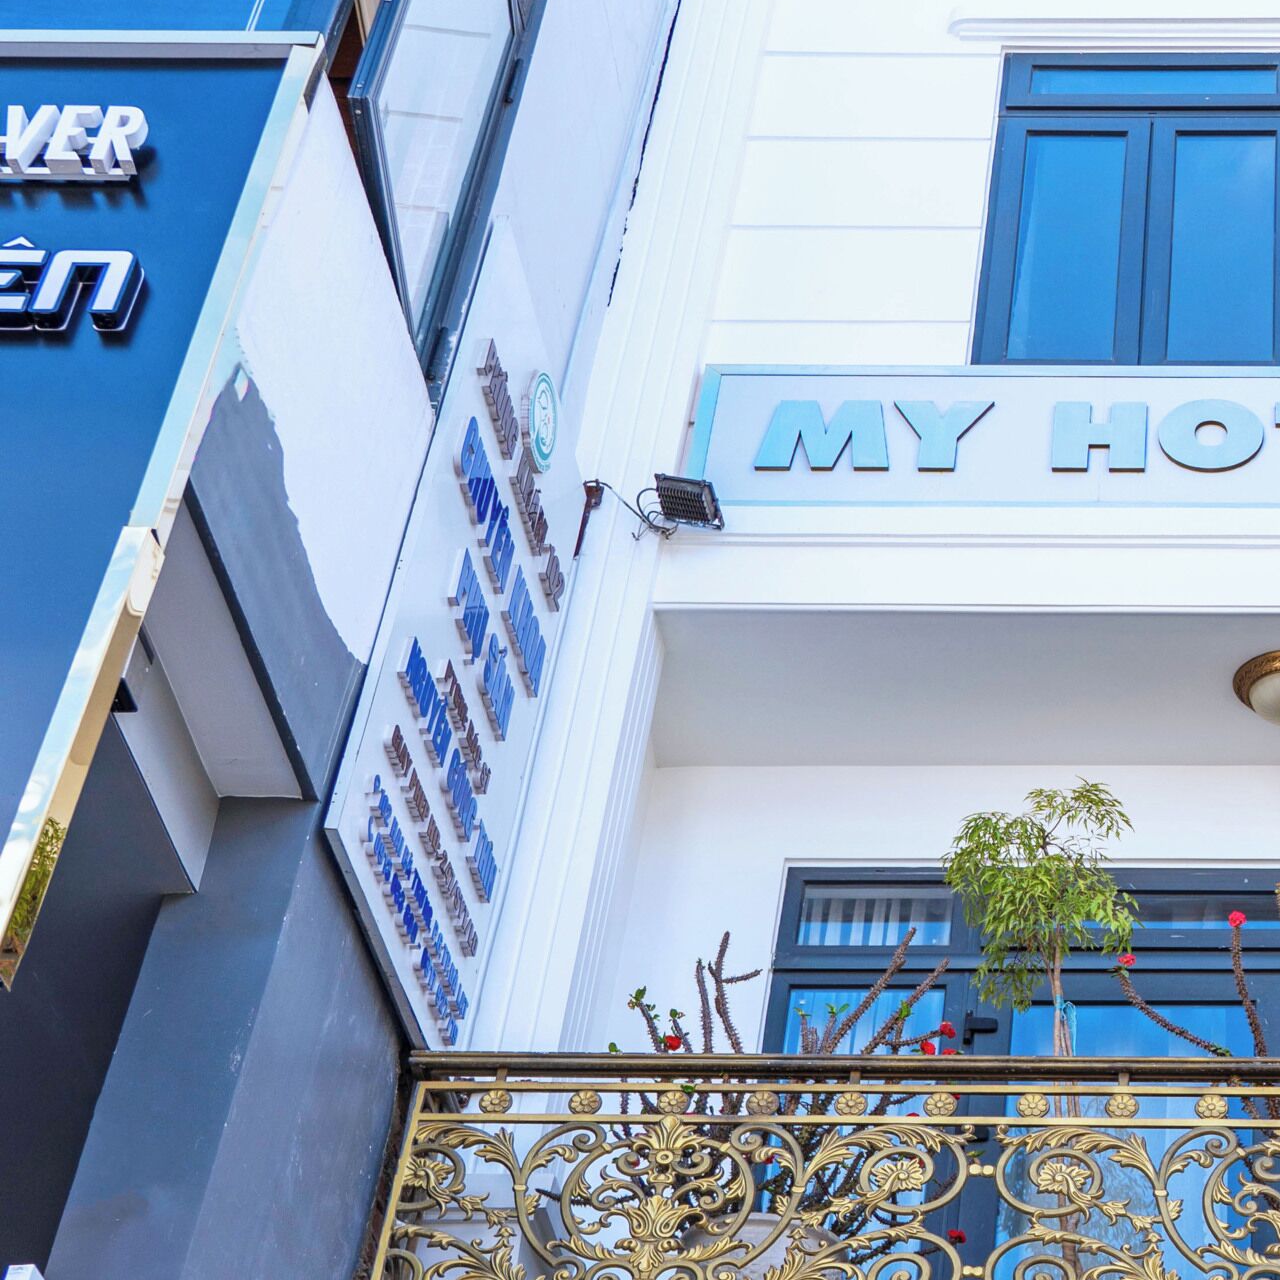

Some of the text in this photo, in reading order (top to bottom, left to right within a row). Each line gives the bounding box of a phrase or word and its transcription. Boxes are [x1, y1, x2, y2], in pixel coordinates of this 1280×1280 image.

[515, 447, 548, 556] KHÁM
[543, 544, 565, 612] 102
[754, 400, 995, 472] MY
[454, 547, 515, 742] PHỤ SẢN
[459, 416, 547, 697] CHUYÊN KHOA
[405, 636, 498, 903] NGUYỄN CÔNG THÌN
